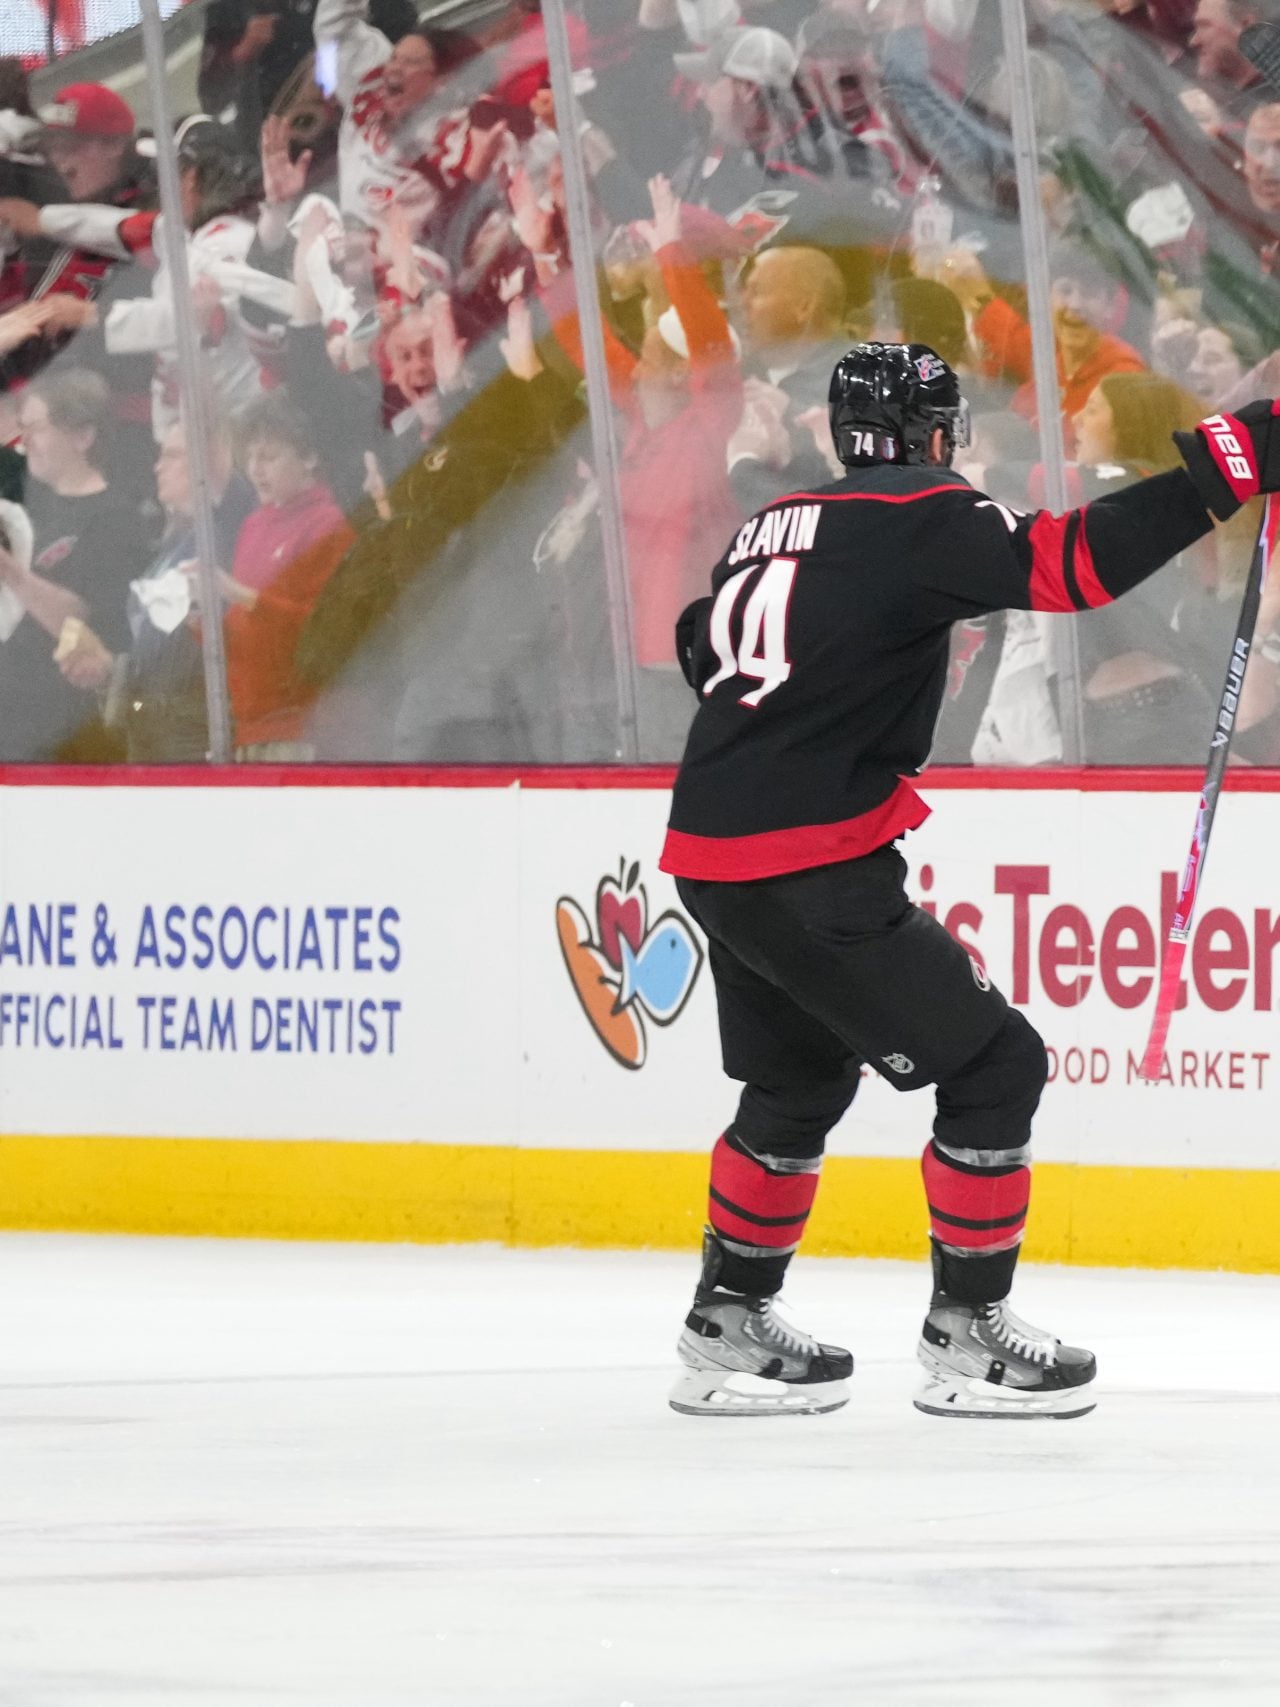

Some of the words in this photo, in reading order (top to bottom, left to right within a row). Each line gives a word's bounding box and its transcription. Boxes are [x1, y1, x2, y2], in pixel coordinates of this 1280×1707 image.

[850, 431, 875, 457] 74
[728, 504, 822, 566] SLAVIN
[1219, 637, 1251, 732] BAUER
[0, 903, 77, 967] ANE
[92, 902, 118, 968] &
[134, 905, 401, 972] ASSOCIATES
[137, 996, 237, 1052] TEAM
[251, 997, 402, 1055] DENTIST
